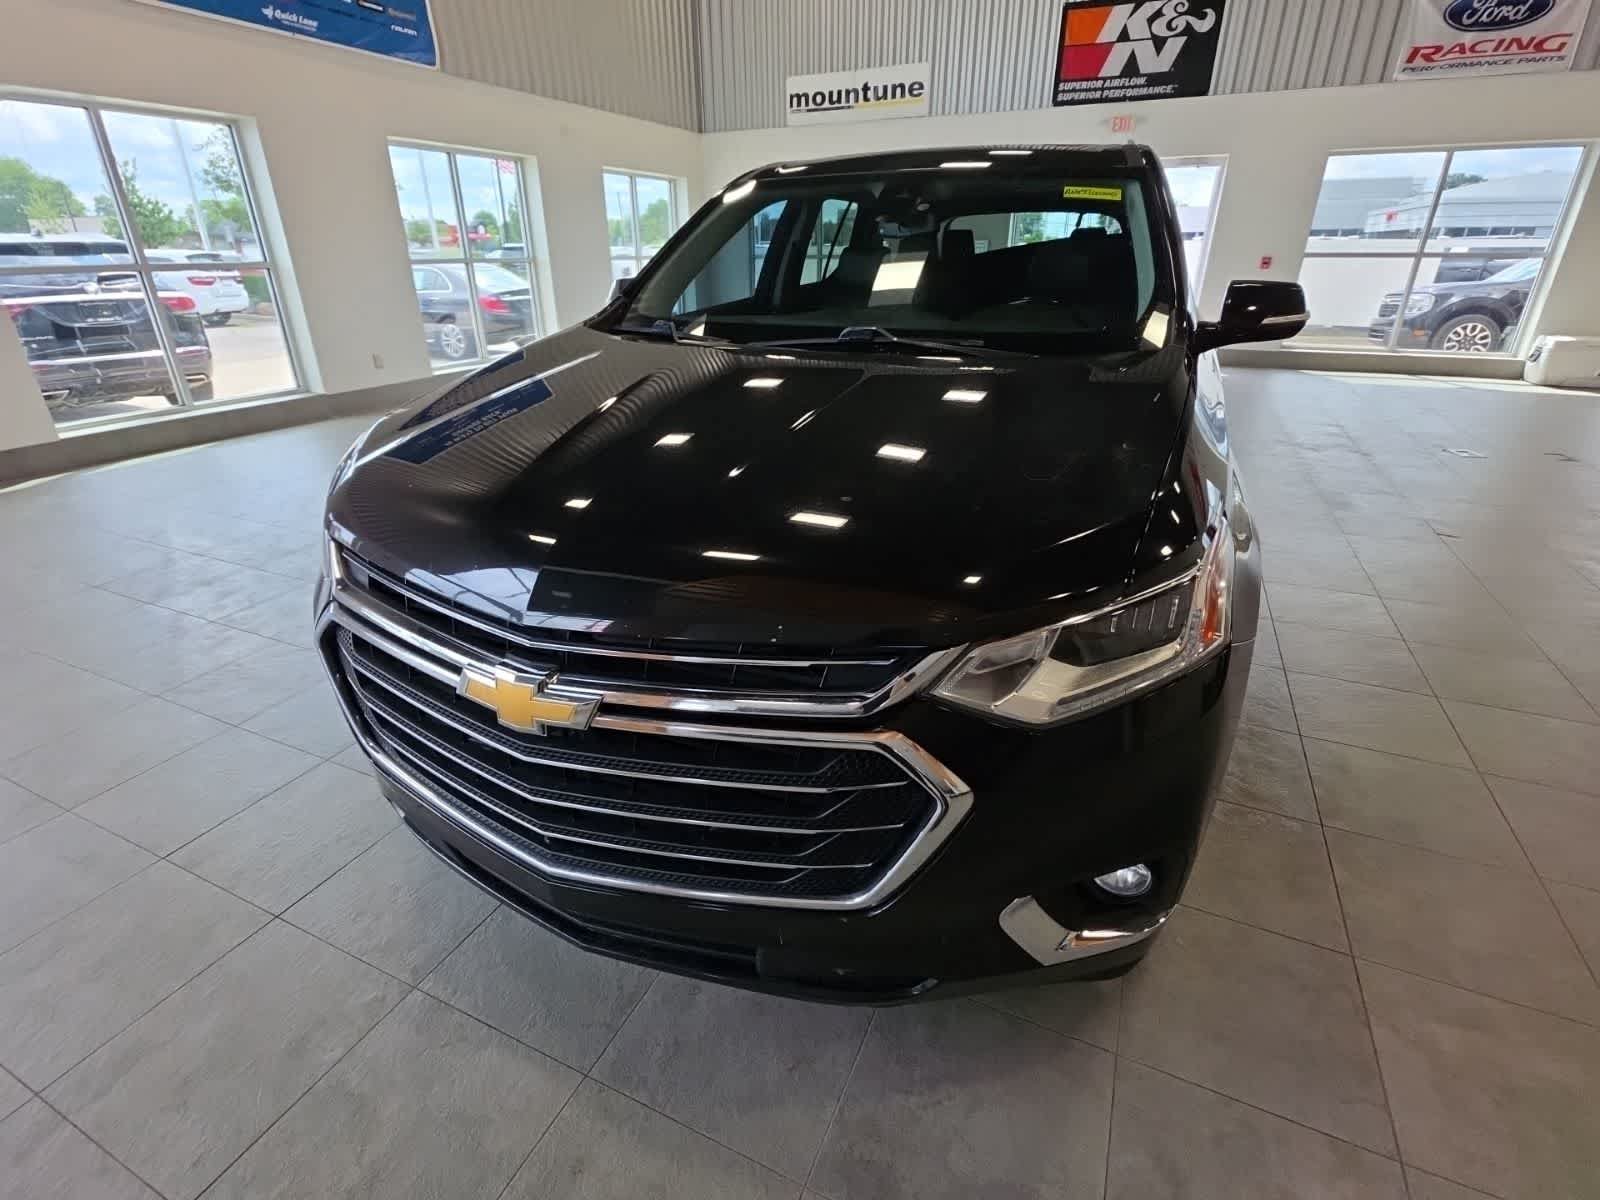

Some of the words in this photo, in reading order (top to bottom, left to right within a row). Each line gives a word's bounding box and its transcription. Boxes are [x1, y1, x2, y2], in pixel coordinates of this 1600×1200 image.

[274, 9, 298, 22] Quick
[1462, 0, 1529, 24] Ford
[1406, 33, 1573, 64] RACING
[1402, 58, 1514, 73] PERFORMANCE
[1518, 55, 1568, 63] PARTS
[1058, 79, 1104, 91] SUPERIOR
[1103, 77, 1148, 88] AIRFLOW.
[789, 81, 925, 109] mountune
[1057, 90, 1102, 101] SUPERIOR
